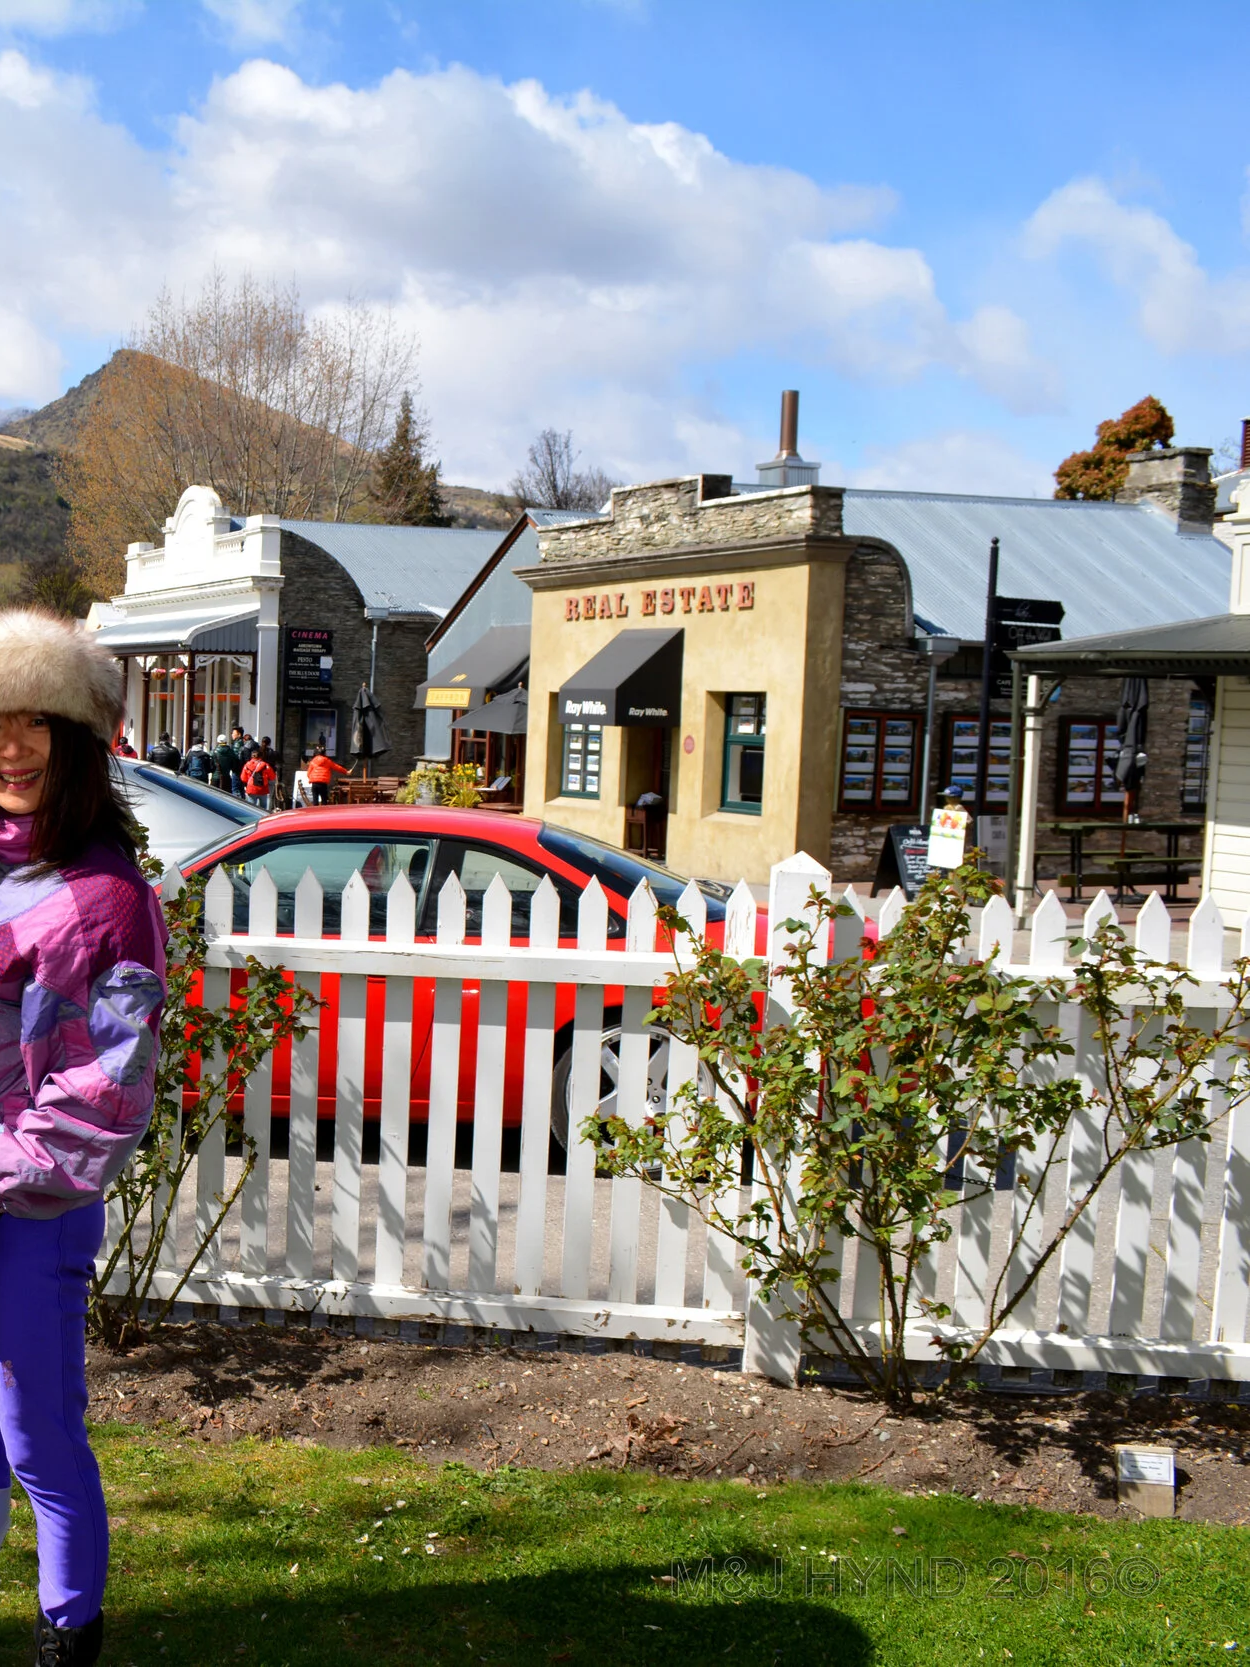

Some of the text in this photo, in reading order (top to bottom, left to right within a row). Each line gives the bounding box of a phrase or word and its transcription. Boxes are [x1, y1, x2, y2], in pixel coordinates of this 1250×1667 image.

[564, 582, 755, 621] REAL ESTATE
[292, 631, 328, 639] CINEMA
[565, 700, 582, 715] Ray
[629, 707, 645, 717] Ray
